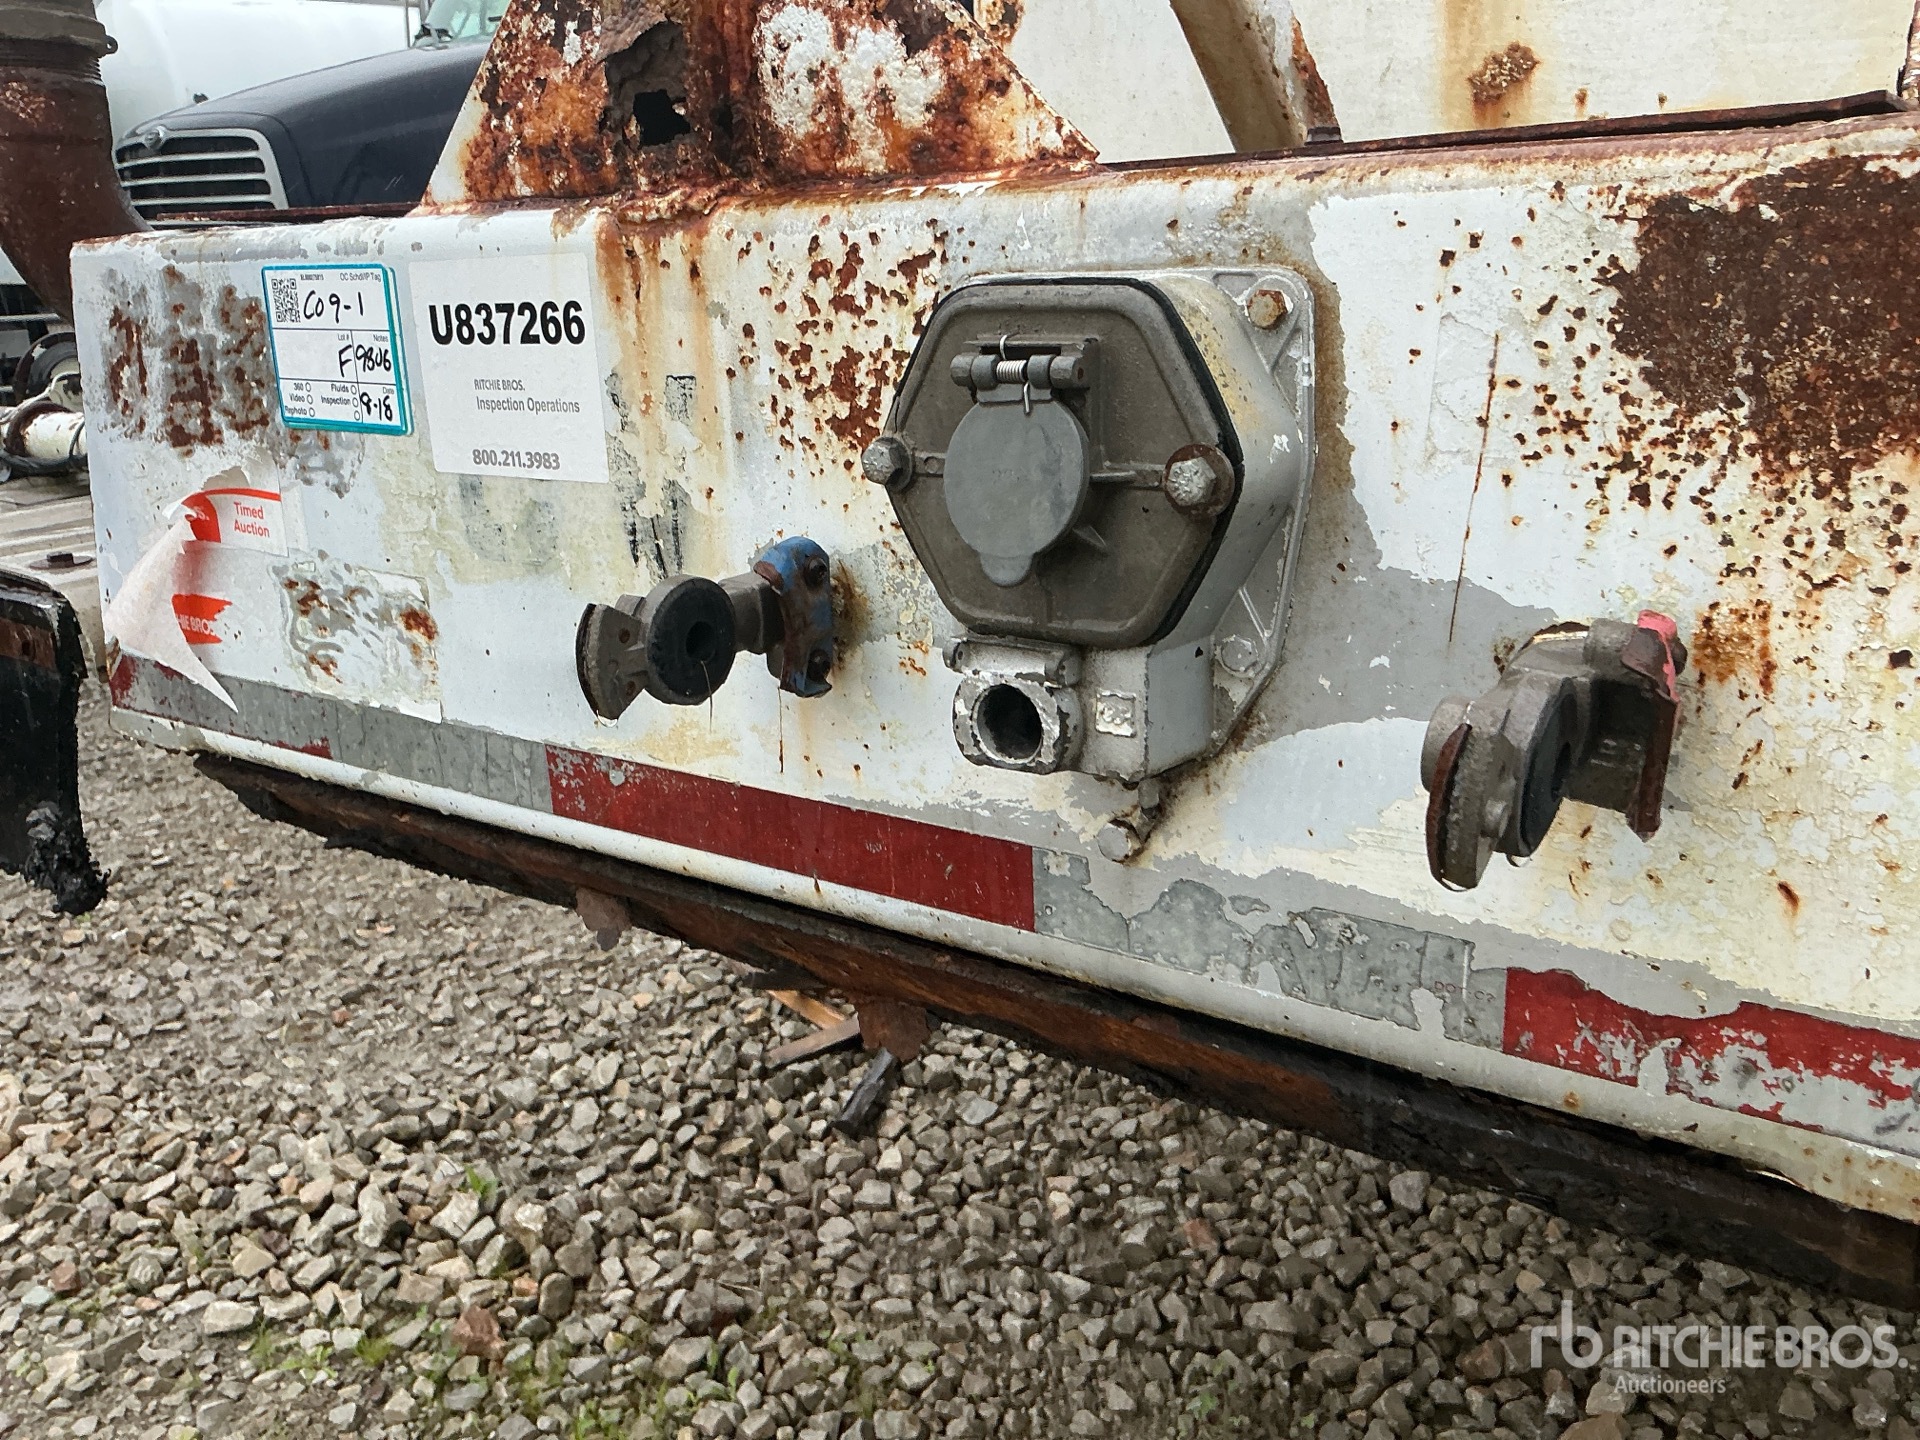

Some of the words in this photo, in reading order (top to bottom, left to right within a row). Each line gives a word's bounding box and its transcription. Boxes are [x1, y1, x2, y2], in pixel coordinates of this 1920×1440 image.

[371, 272, 382, 283] Tag
[428, 300, 586, 346] U837266
[338, 334, 346, 342] Lot
[373, 335, 389, 343] Notes
[293, 383, 304, 391] 360
[330, 383, 349, 393] Fluids
[474, 379, 501, 391] RITCHIE
[502, 379, 526, 392] BROS.
[382, 387, 395, 395] Date
[289, 393, 305, 403] Video
[321, 396, 351, 406] Inspection
[476, 396, 525, 413] Inspection
[527, 397, 580, 415] Operations
[472, 449, 561, 470] 800.211.3983
[233, 501, 264, 520] Timed
[233, 521, 270, 539] Auction
